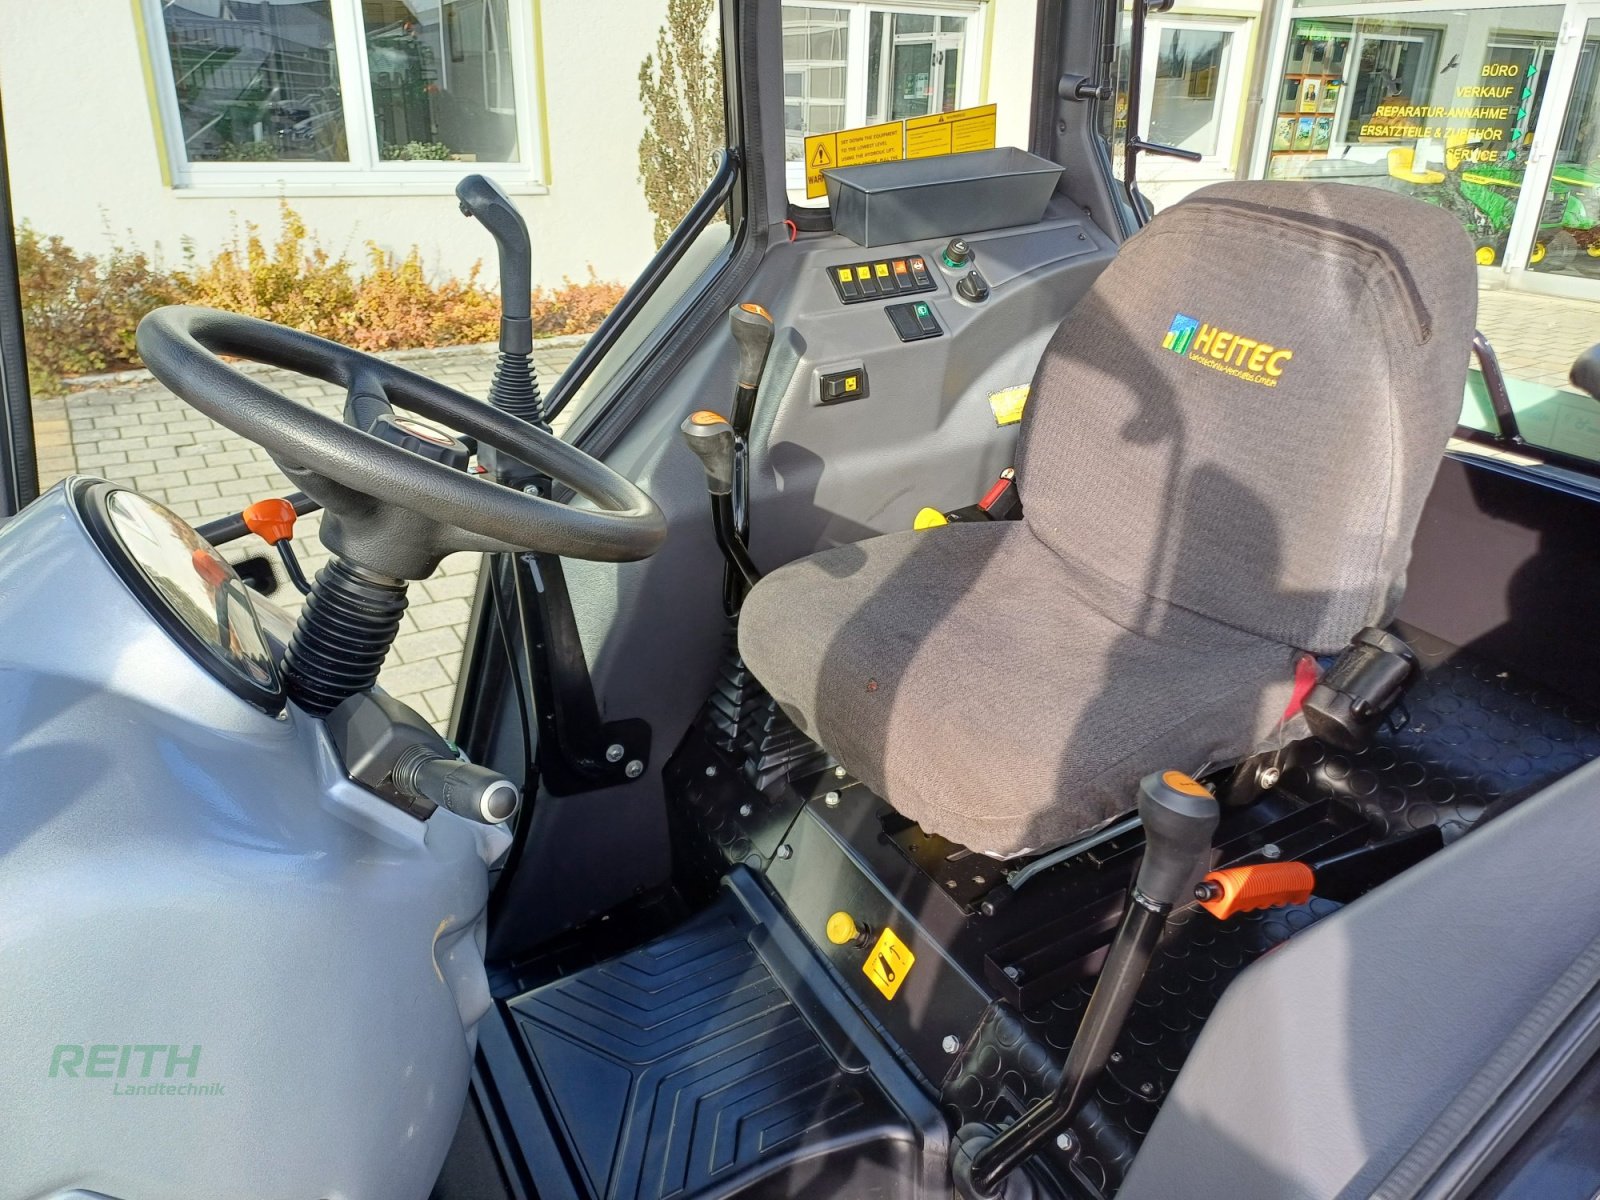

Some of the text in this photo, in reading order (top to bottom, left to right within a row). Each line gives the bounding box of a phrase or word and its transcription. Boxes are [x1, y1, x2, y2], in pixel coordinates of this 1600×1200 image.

[1481, 63, 1519, 77] BÜRO
[1456, 86, 1514, 98] VERKAUF
[1376, 105, 1508, 120] REPARATUR-ANNAHME
[1360, 125, 1502, 141] ERSATZTEILE & ZUBEHÖR
[1446, 148, 1498, 162] SERVICE
[1193, 323, 1293, 377] HEITEC
